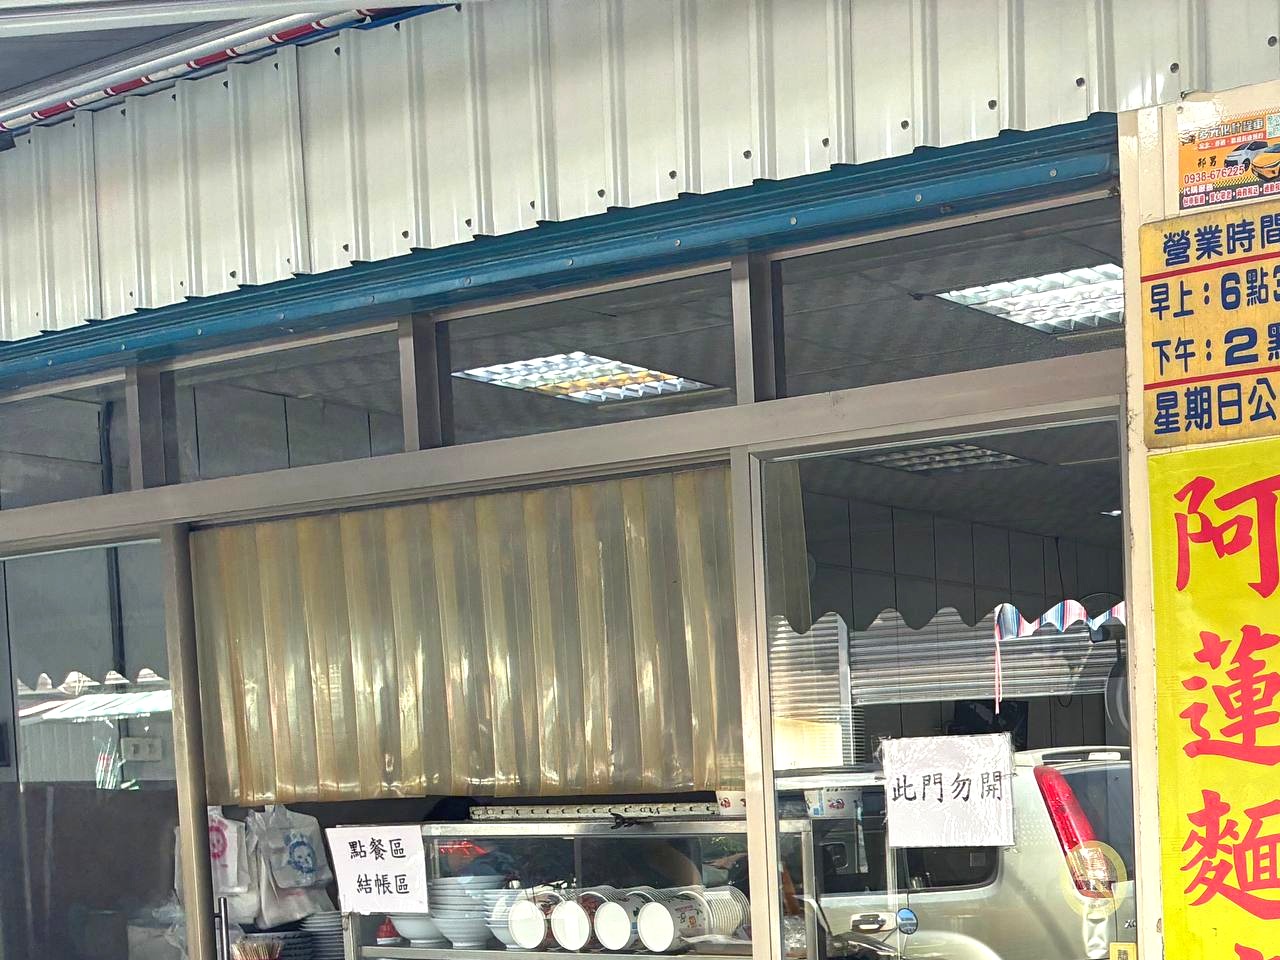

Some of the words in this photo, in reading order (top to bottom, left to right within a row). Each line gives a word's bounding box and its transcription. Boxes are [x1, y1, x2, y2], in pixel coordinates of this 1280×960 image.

[892, 770, 1002, 803] 此門勿開
[348, 837, 407, 861] 點餐區
[356, 873, 410, 895] 結帳區
